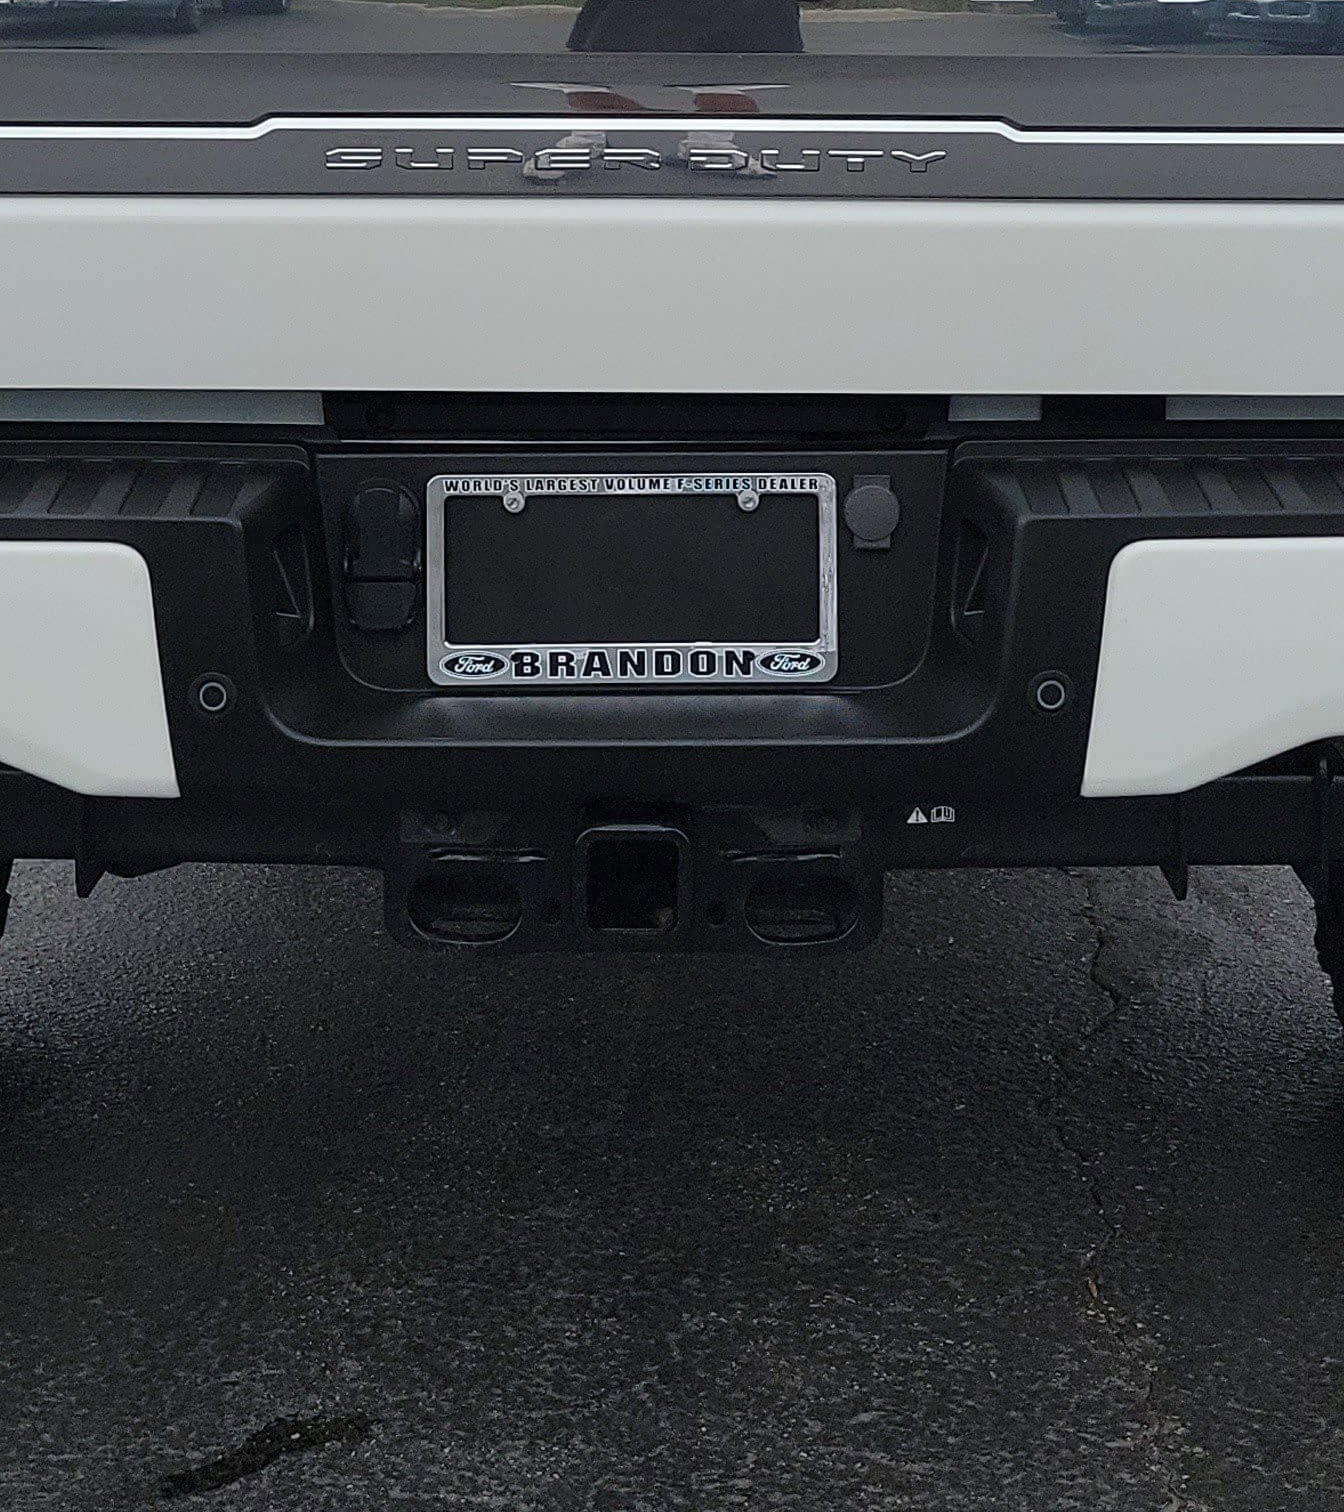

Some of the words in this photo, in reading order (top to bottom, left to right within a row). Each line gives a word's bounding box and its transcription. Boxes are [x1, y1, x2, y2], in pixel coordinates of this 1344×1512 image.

[324, 147, 661, 172] SUPER
[689, 146, 948, 173] DUTY
[444, 478, 519, 492] WORLD'S
[525, 478, 599, 492] LARGEST
[605, 478, 670, 491] VOLUME
[677, 477, 752, 490] F-SERIES
[758, 477, 818, 490] DEALER
[455, 656, 495, 674] Ford
[511, 649, 755, 678] BRANDON
[769, 653, 811, 672] Ford
